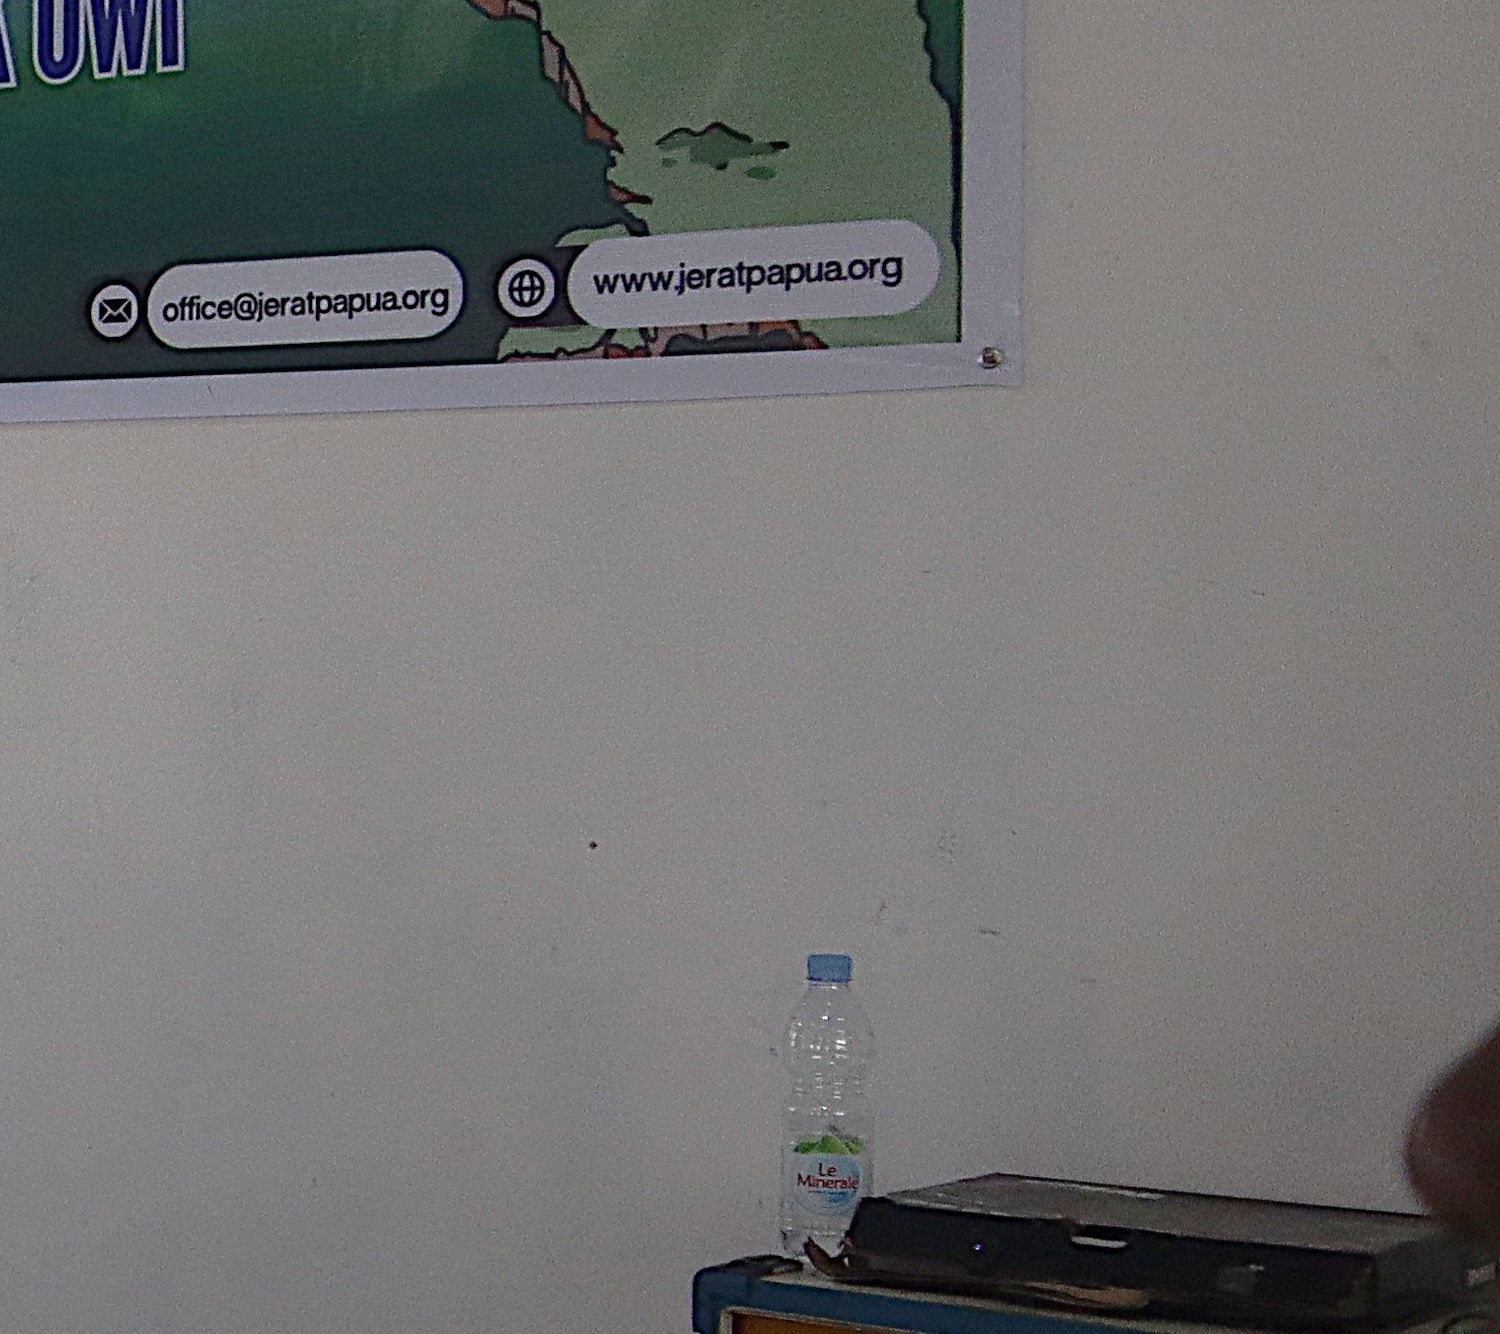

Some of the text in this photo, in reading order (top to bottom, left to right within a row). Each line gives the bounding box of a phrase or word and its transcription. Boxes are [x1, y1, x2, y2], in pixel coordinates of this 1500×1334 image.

[592, 253, 904, 296] www.jeratpapua.org
[162, 284, 450, 323] office@jeratpapua.org
[797, 1173, 859, 1190] Minerale
[818, 1162, 837, 1177] Le
